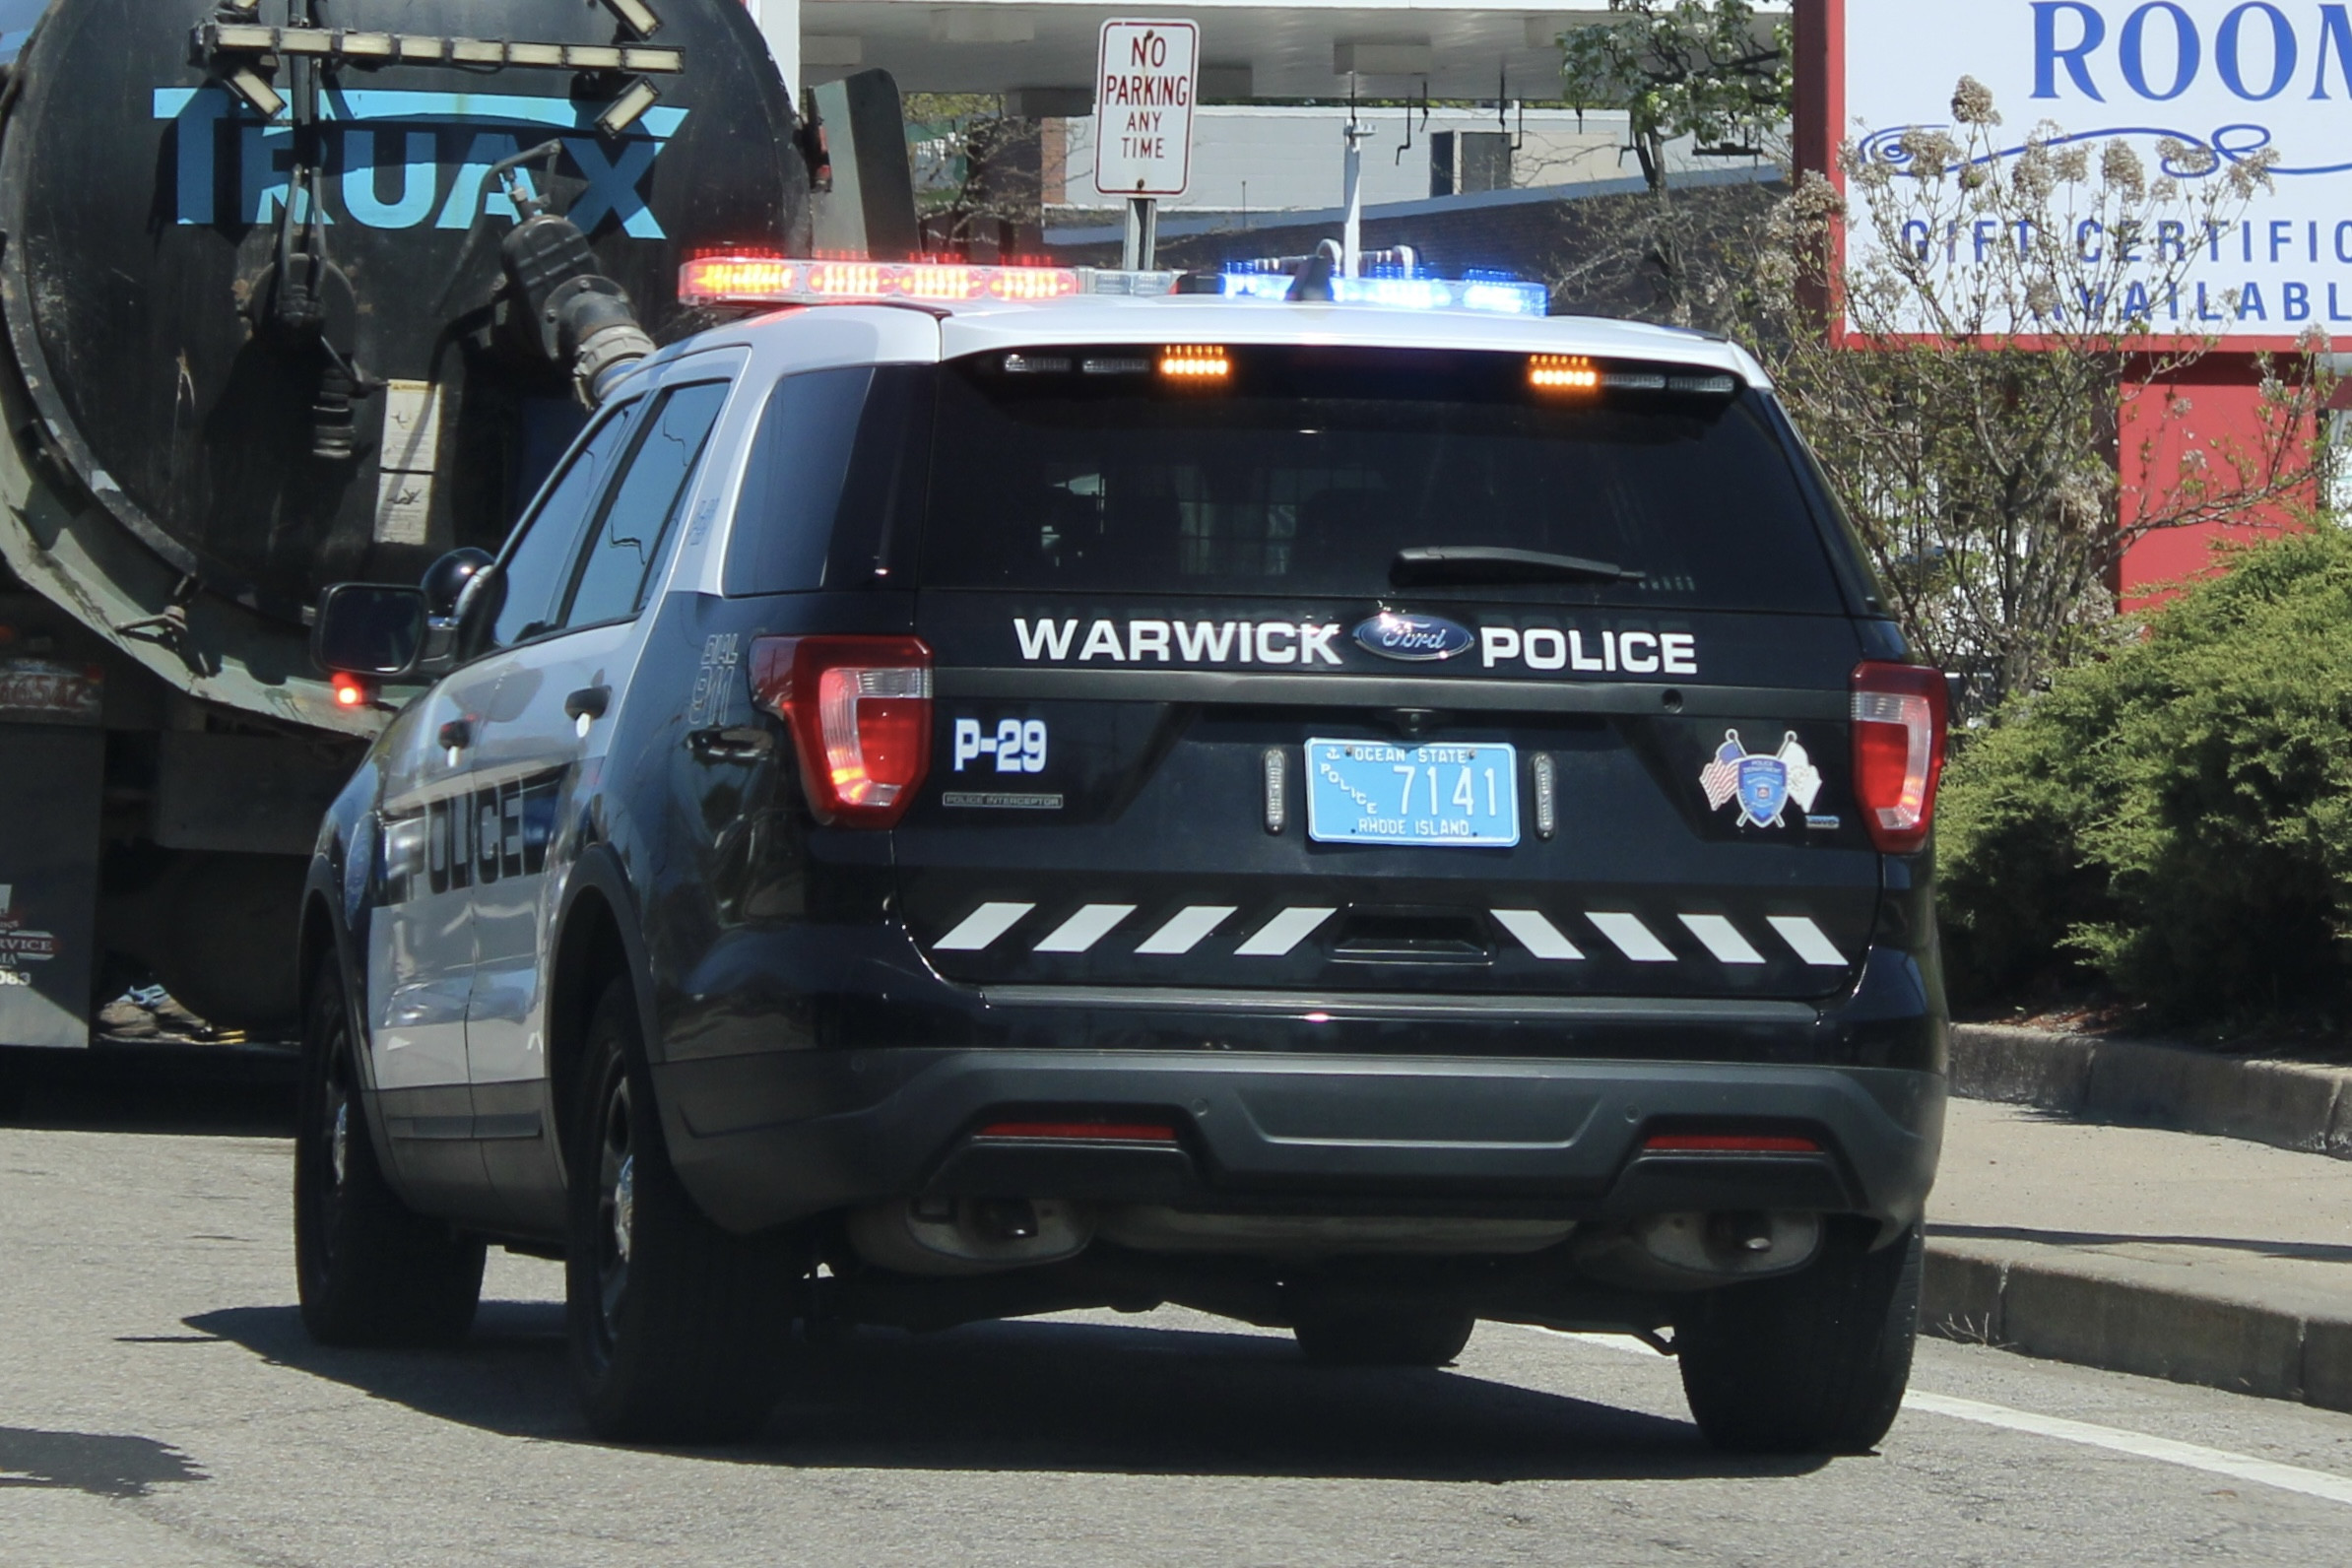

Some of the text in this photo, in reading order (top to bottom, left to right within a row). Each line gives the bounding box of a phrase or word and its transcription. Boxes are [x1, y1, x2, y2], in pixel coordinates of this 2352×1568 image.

[1131, 36, 1166, 68] NO
[1105, 75, 1188, 106] PARKING
[1126, 111, 1163, 132] ANY
[154, 87, 690, 240] TRUAX
[1121, 137, 1165, 159] TIME
[1901, 220, 2037, 263] GIFT
[1013, 618, 1343, 665] WARWICK
[1381, 621, 1447, 649] Ford
[1479, 626, 1698, 675] POLICE
[688, 665, 736, 726] 911
[953, 718, 1047, 773] P-29
[1354, 748, 1469, 763] OCEAN STATE
[946, 796, 1060, 806] POLICE INTERCEPTOR
[1320, 762, 1377, 815] POLICE
[1393, 764, 1496, 817] 7141
[1358, 818, 1470, 836] RHODE ISLAND
